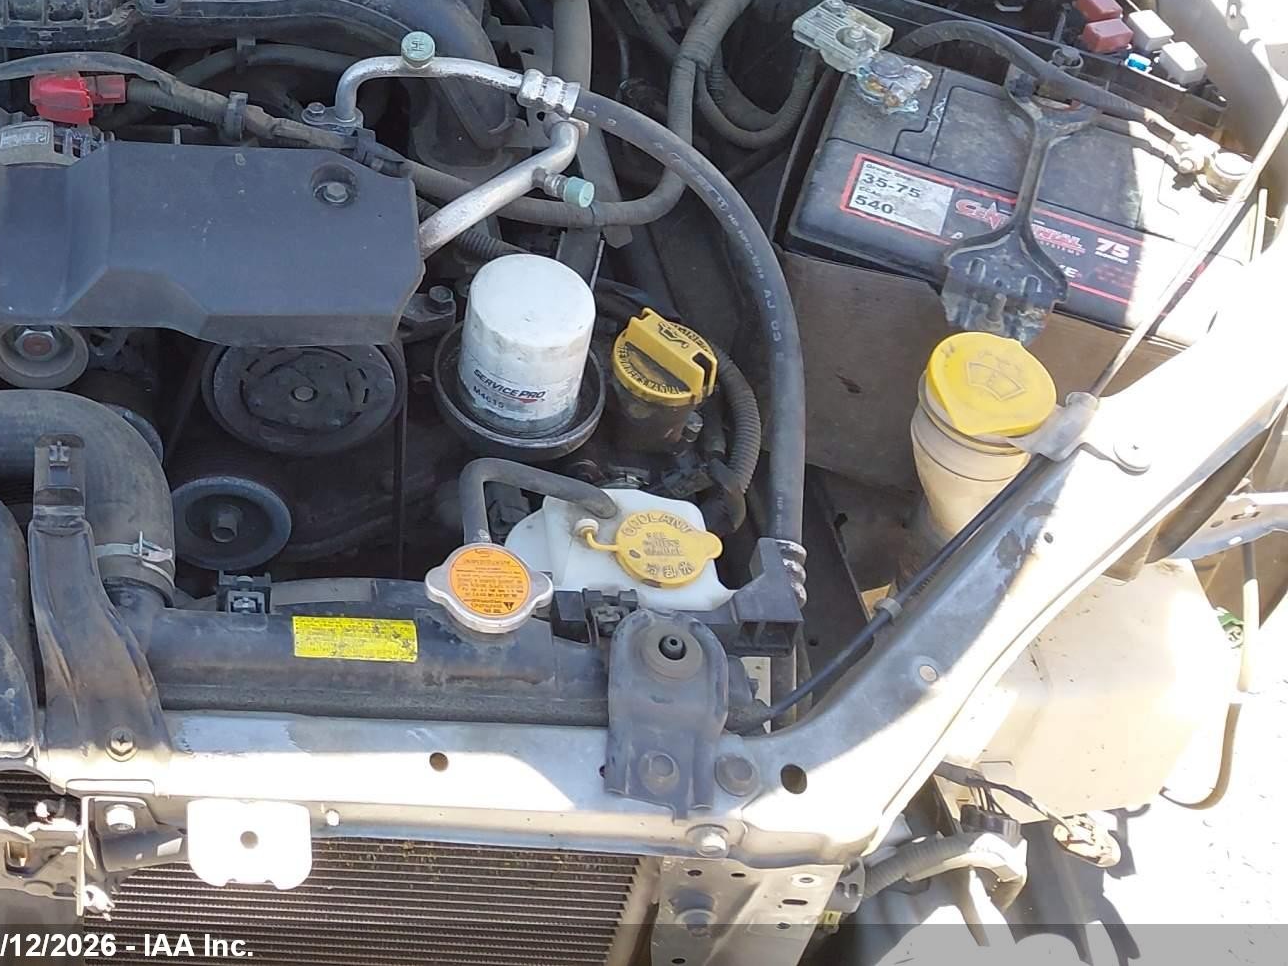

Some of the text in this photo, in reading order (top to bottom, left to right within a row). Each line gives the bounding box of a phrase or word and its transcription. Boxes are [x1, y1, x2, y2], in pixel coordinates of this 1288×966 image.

[863, 173, 921, 198] 35-75
[855, 194, 894, 215] 540
[1095, 237, 1130, 258] 75
[621, 513, 692, 537] COOLANT
